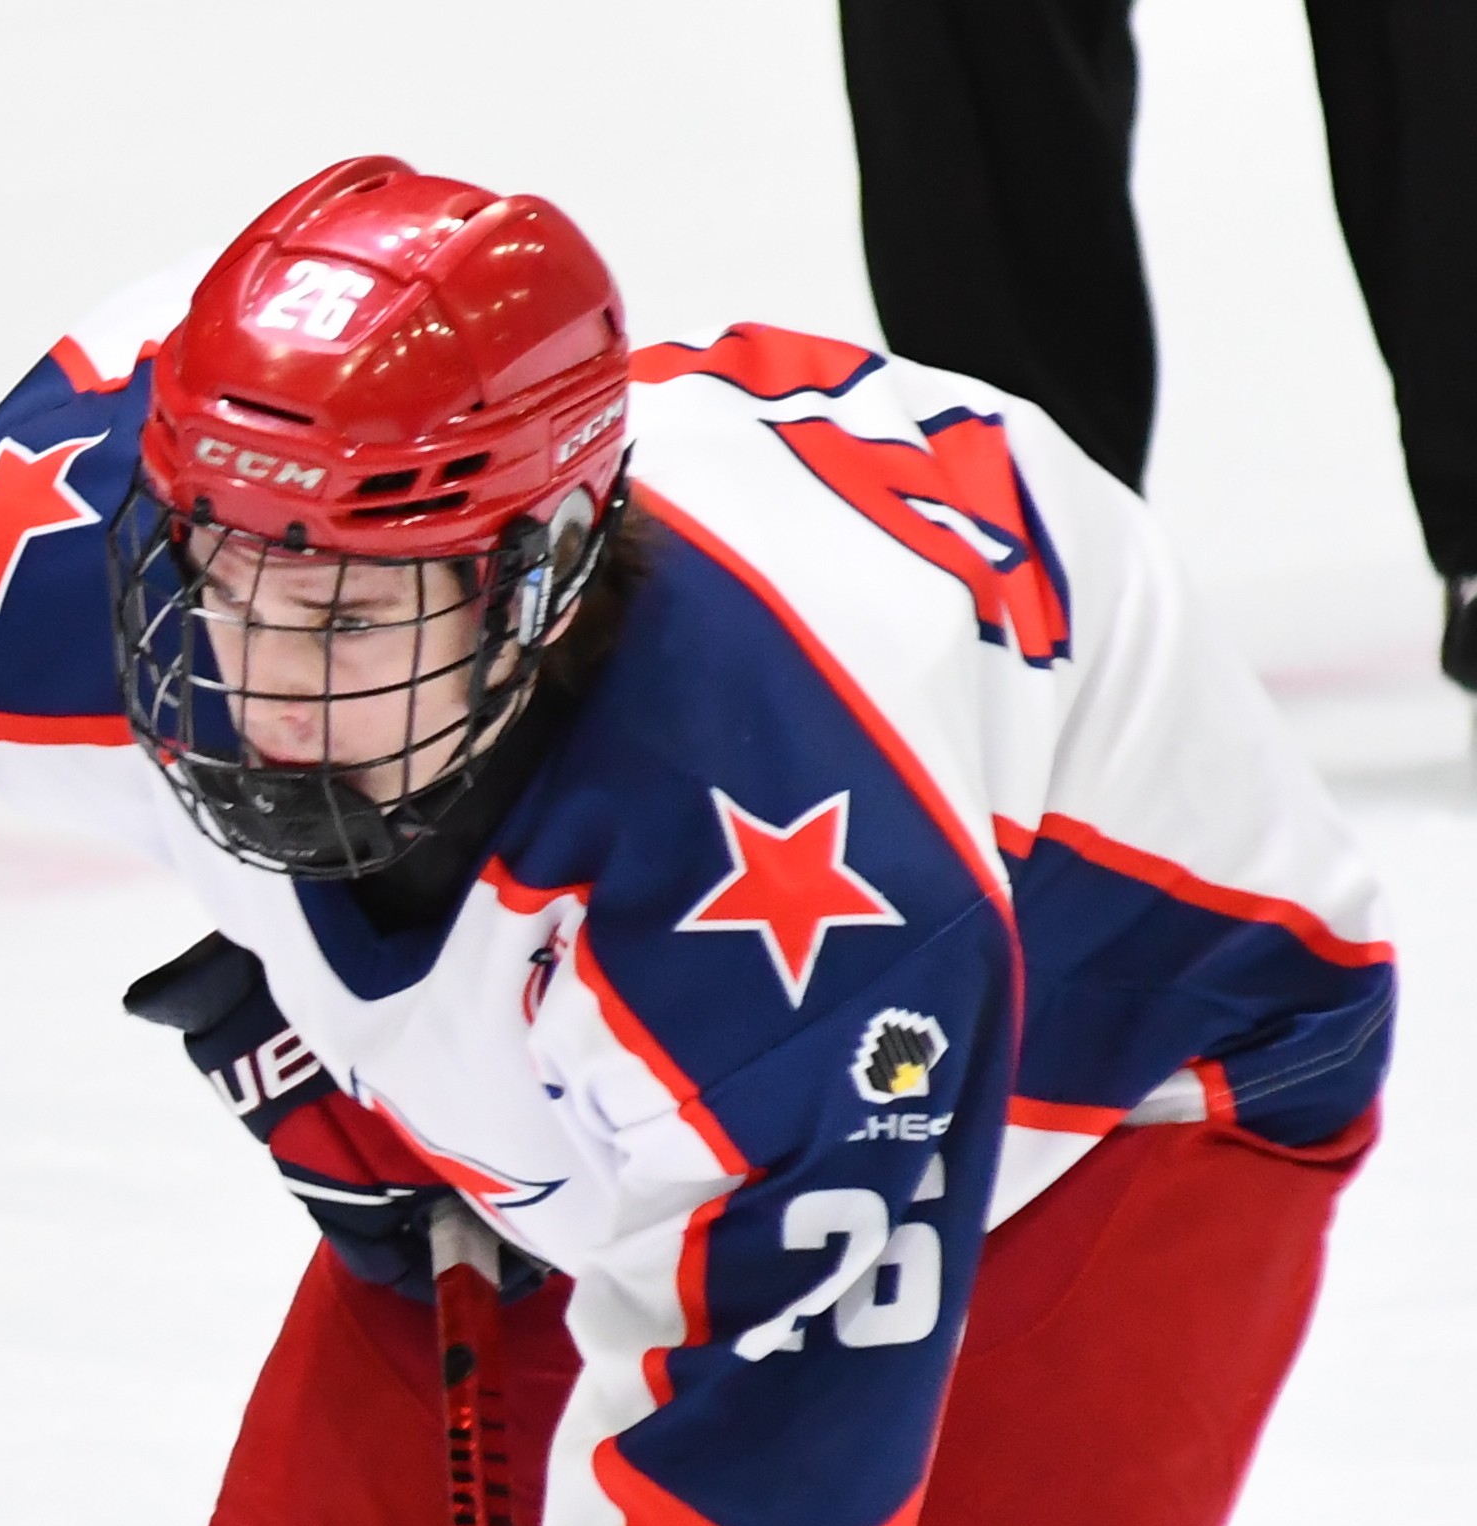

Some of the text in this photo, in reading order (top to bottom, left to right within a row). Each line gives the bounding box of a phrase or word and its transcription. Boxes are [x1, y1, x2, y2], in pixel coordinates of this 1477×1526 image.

[256, 259, 376, 341] 26
[197, 437, 327, 490] CCM
[556, 396, 626, 465] CCM
[734, 1152, 945, 1362] 26
